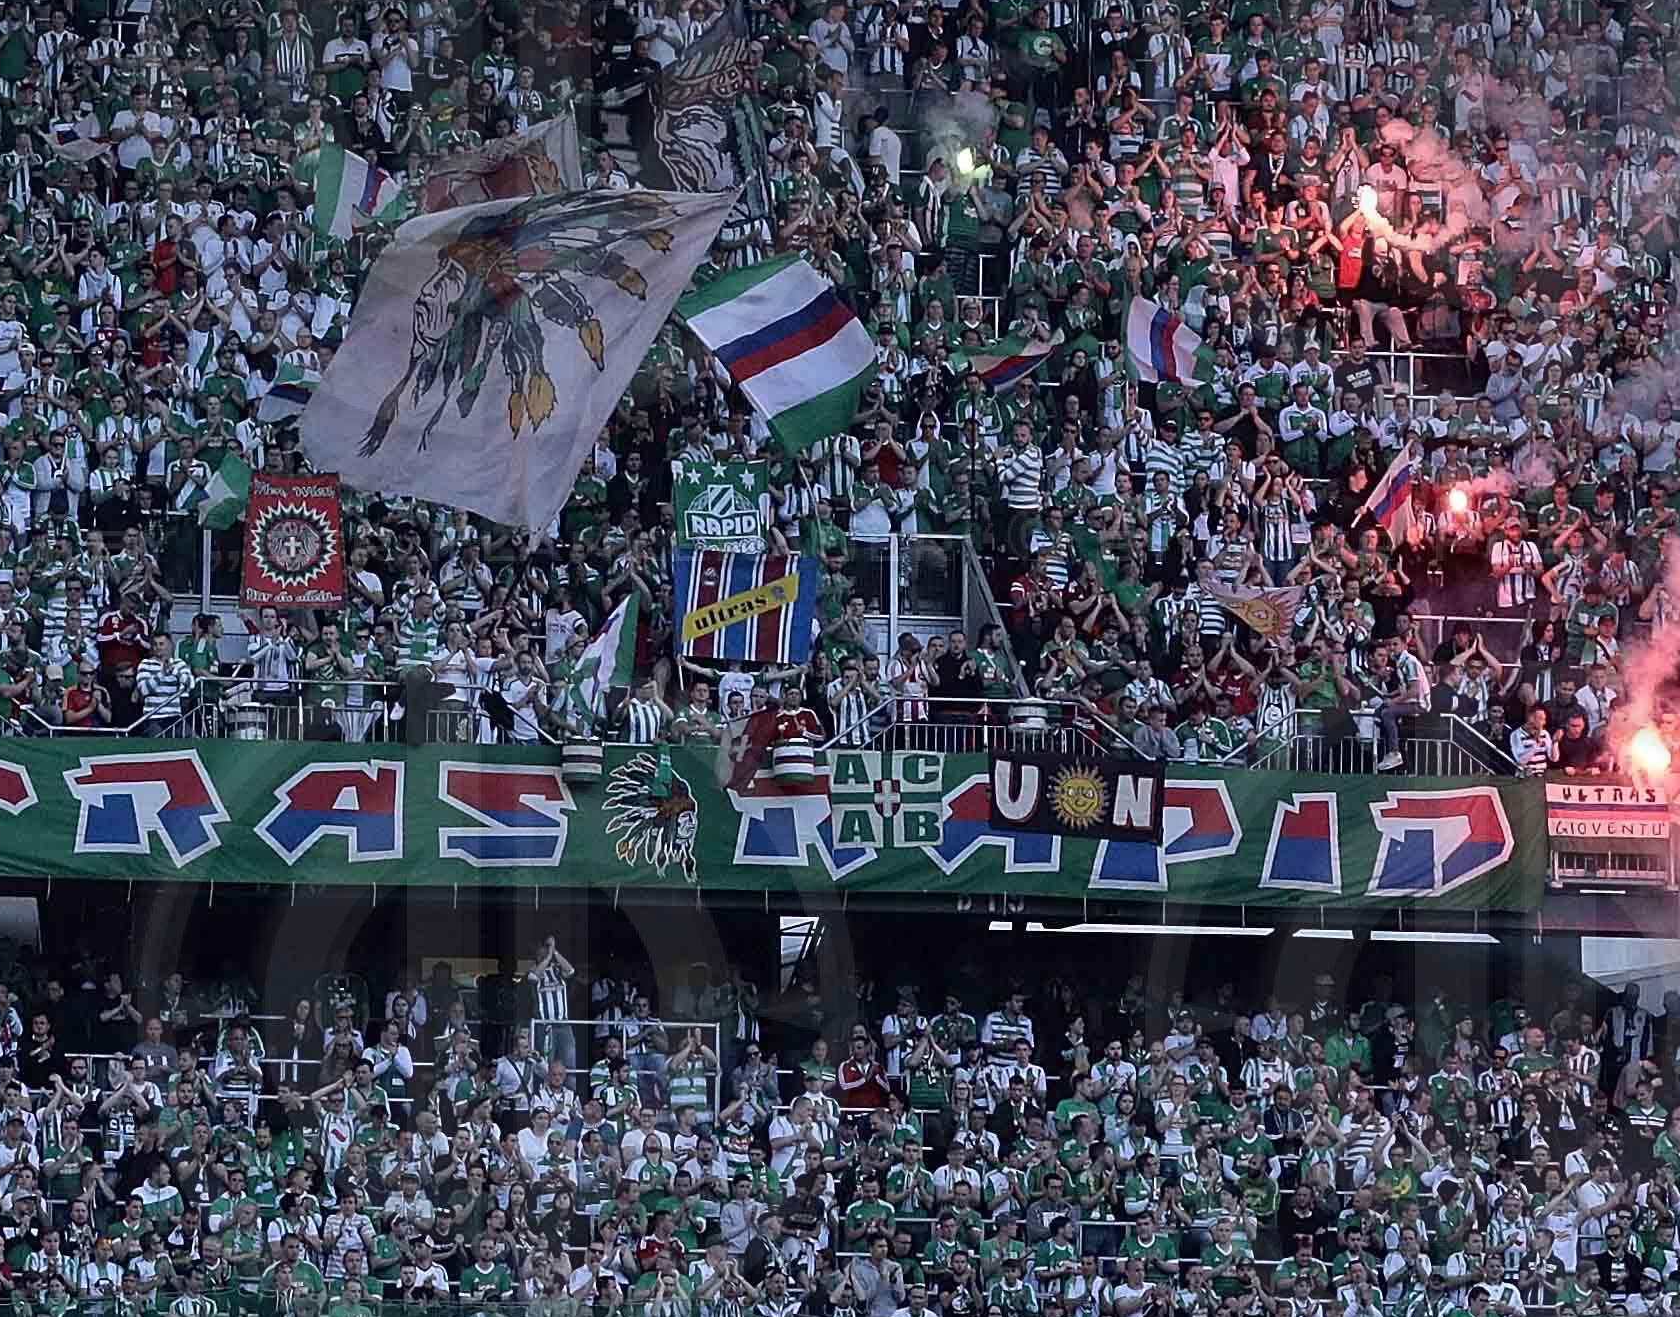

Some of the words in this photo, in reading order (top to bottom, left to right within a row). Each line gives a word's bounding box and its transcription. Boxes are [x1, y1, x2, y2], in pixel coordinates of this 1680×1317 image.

[692, 519, 758, 536] RAPID
[694, 593, 769, 633] ultras
[1563, 788, 1656, 802] ULTRAS
